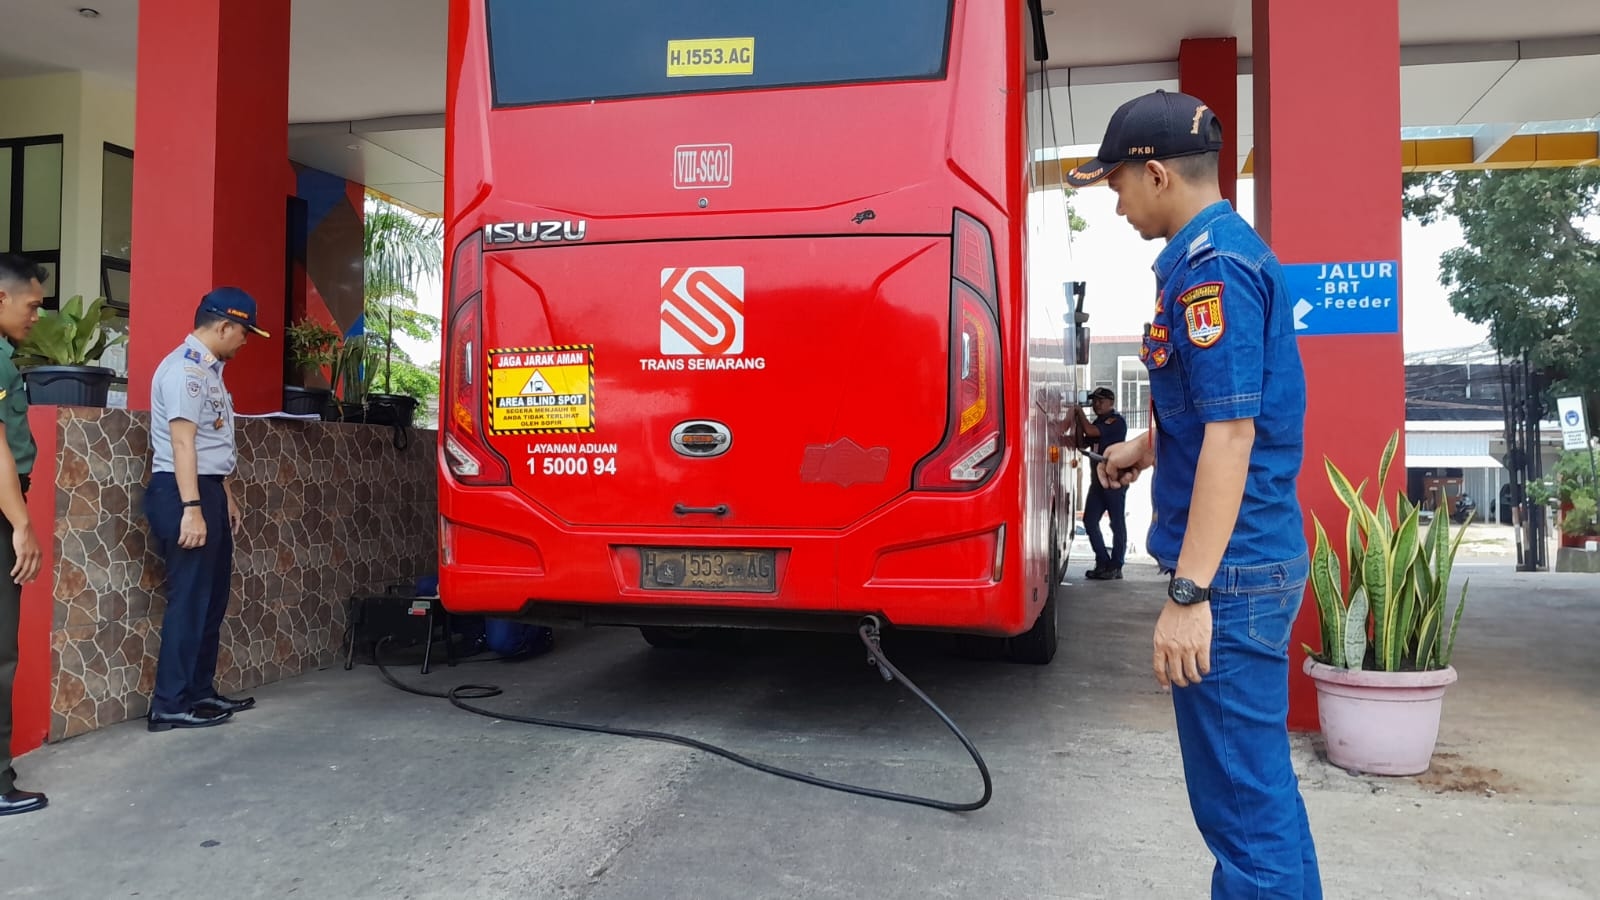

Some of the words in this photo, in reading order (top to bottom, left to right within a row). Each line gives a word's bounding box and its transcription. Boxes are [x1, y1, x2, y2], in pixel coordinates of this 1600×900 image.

[670, 47, 750, 65] H.1553.AG
[485, 220, 586, 243] ISUZU
[1317, 262, 1392, 279] JALUR
[498, 356, 522, 367] JAGA
[524, 354, 555, 366] JARAK
[556, 353, 583, 364] AMAN
[639, 358, 685, 371] TRANS
[687, 357, 766, 370] SEMARANG
[499, 398, 524, 407] AREA
[526, 396, 556, 406] BLIND
[558, 395, 583, 404] SPOT
[527, 443, 577, 454] LAYANAN
[578, 443, 617, 454] ADUAN
[526, 457, 535, 475] 1
[543, 457, 588, 475] 5000
[593, 457, 617, 475] 94
[645, 553, 657, 576] H
[681, 554, 724, 577] 1553
[747, 555, 770, 578] AG
